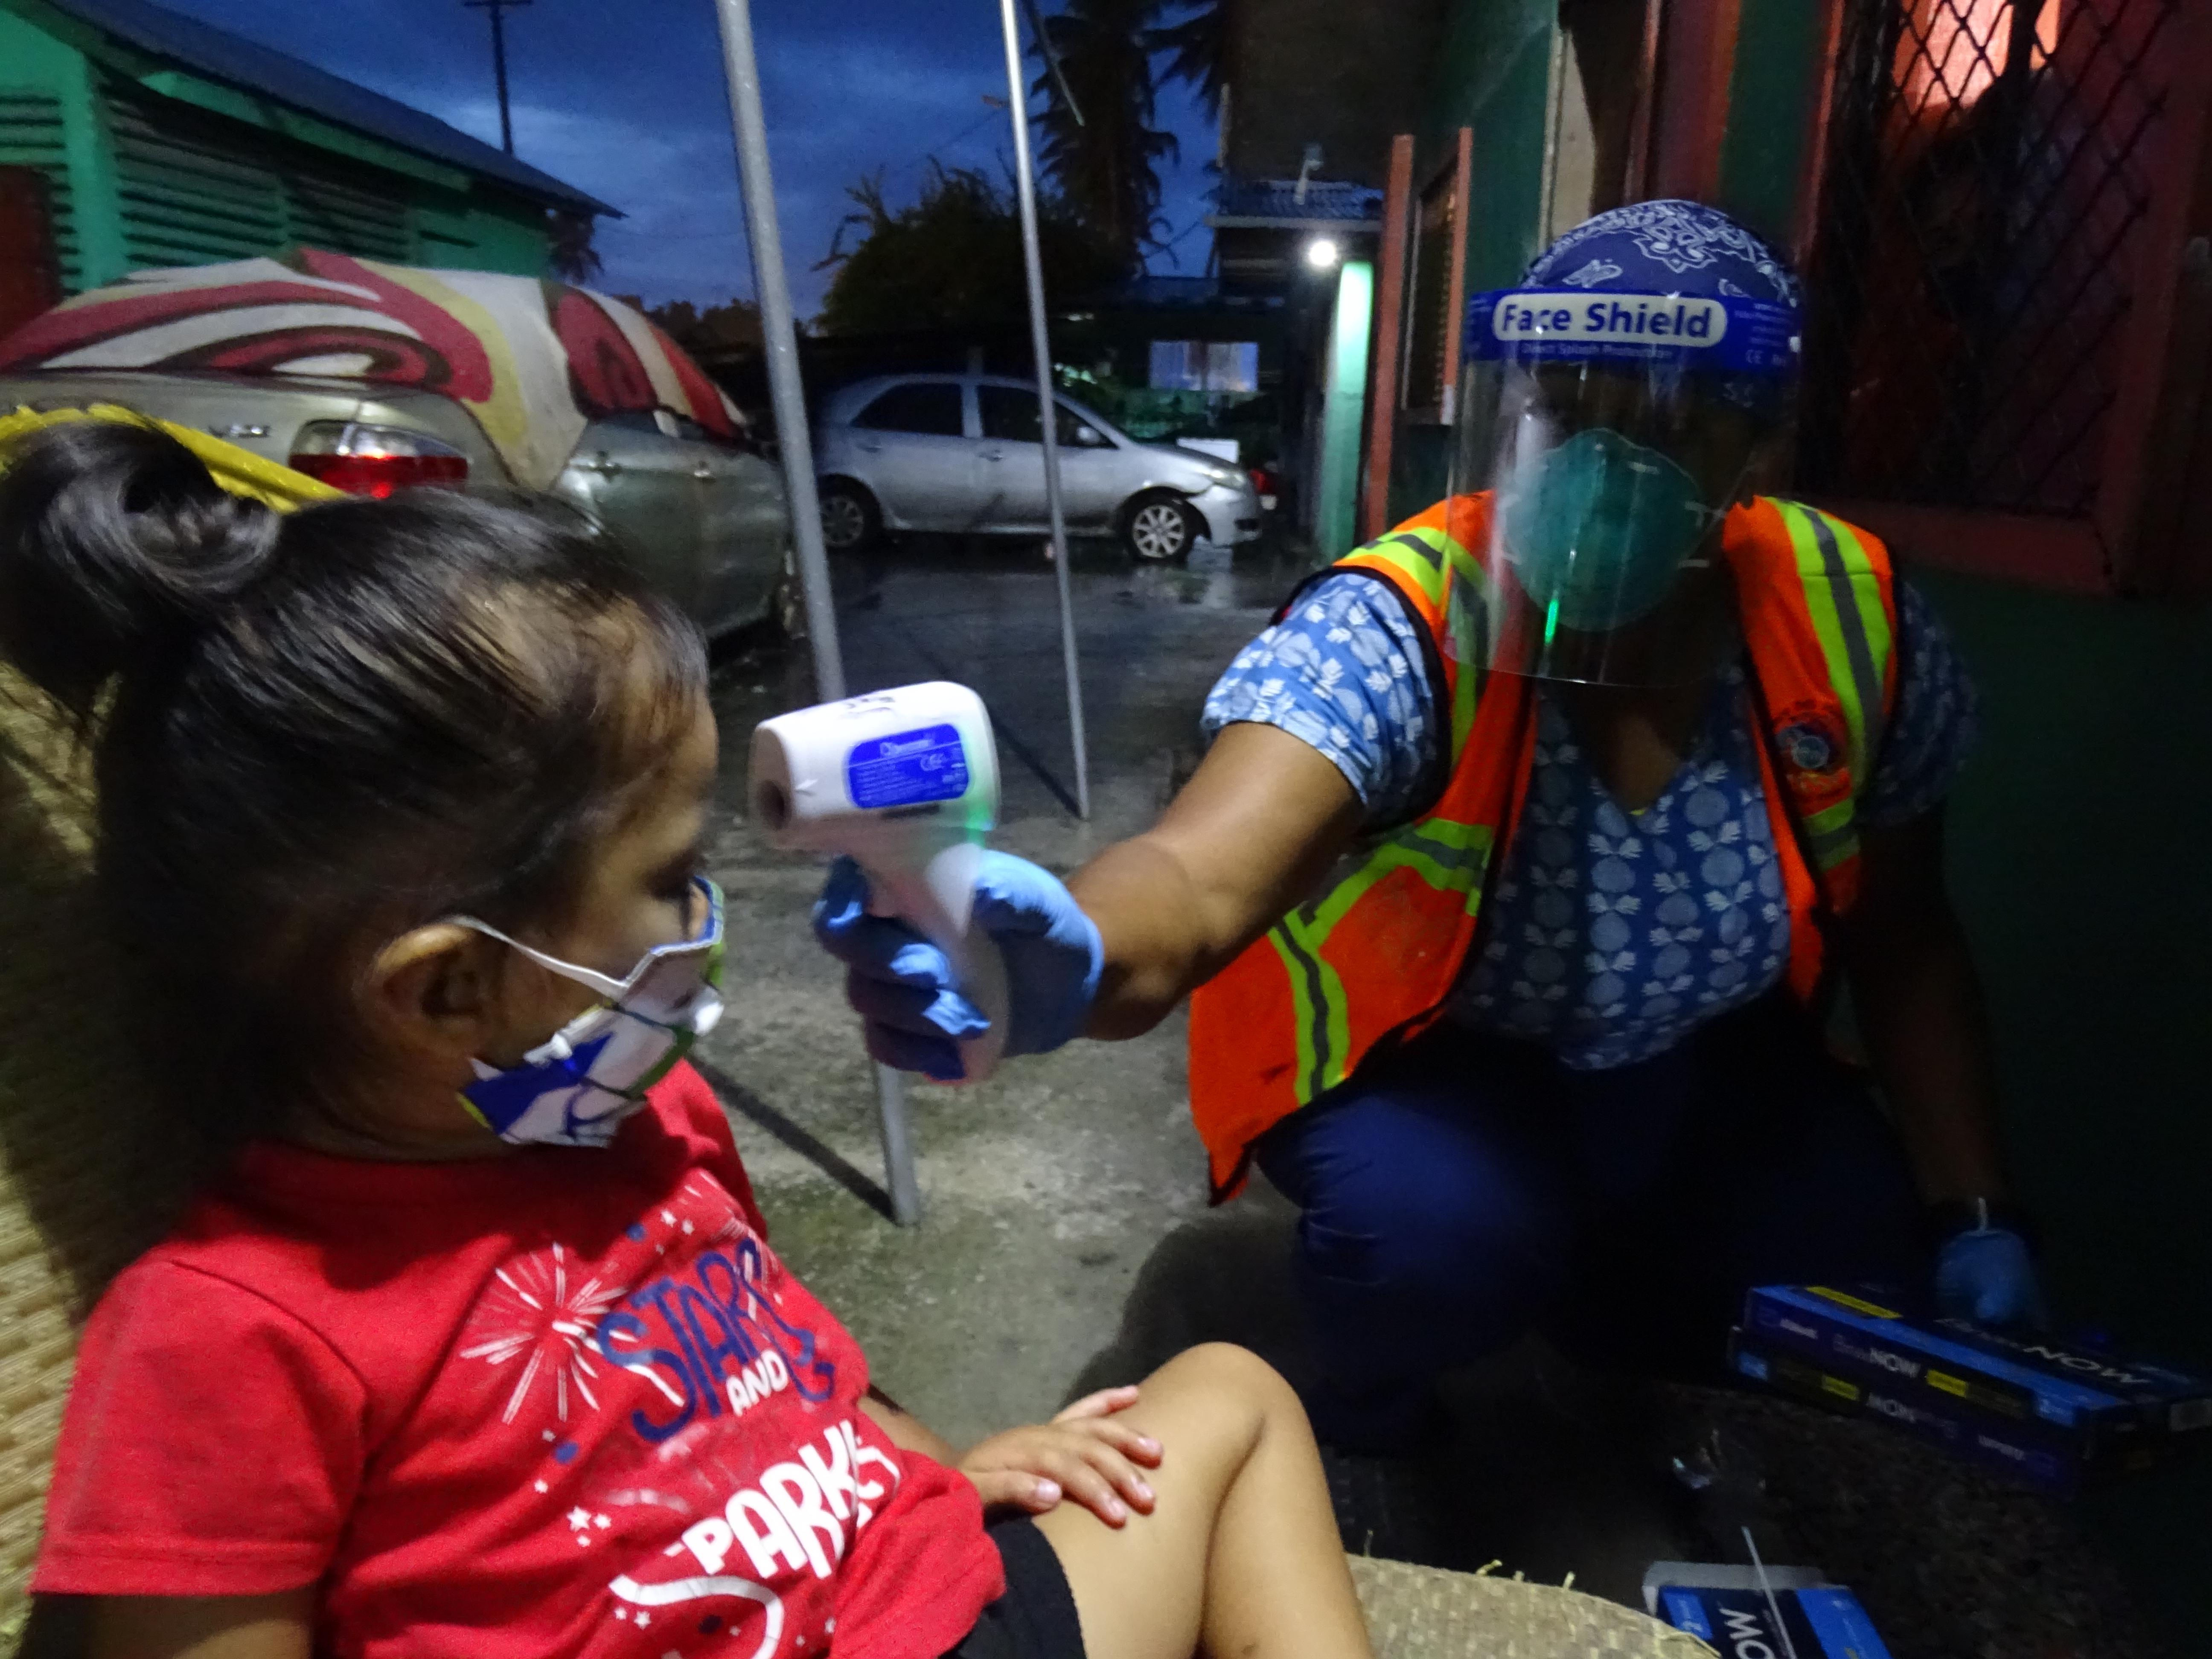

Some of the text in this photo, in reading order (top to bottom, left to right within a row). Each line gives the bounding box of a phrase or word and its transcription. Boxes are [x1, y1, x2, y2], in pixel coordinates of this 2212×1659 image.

[1501, 303, 1572, 332] Face
[1585, 302, 1710, 339] Shield
[597, 1238, 835, 1442] STARS
[727, 1350, 789, 1416] AND
